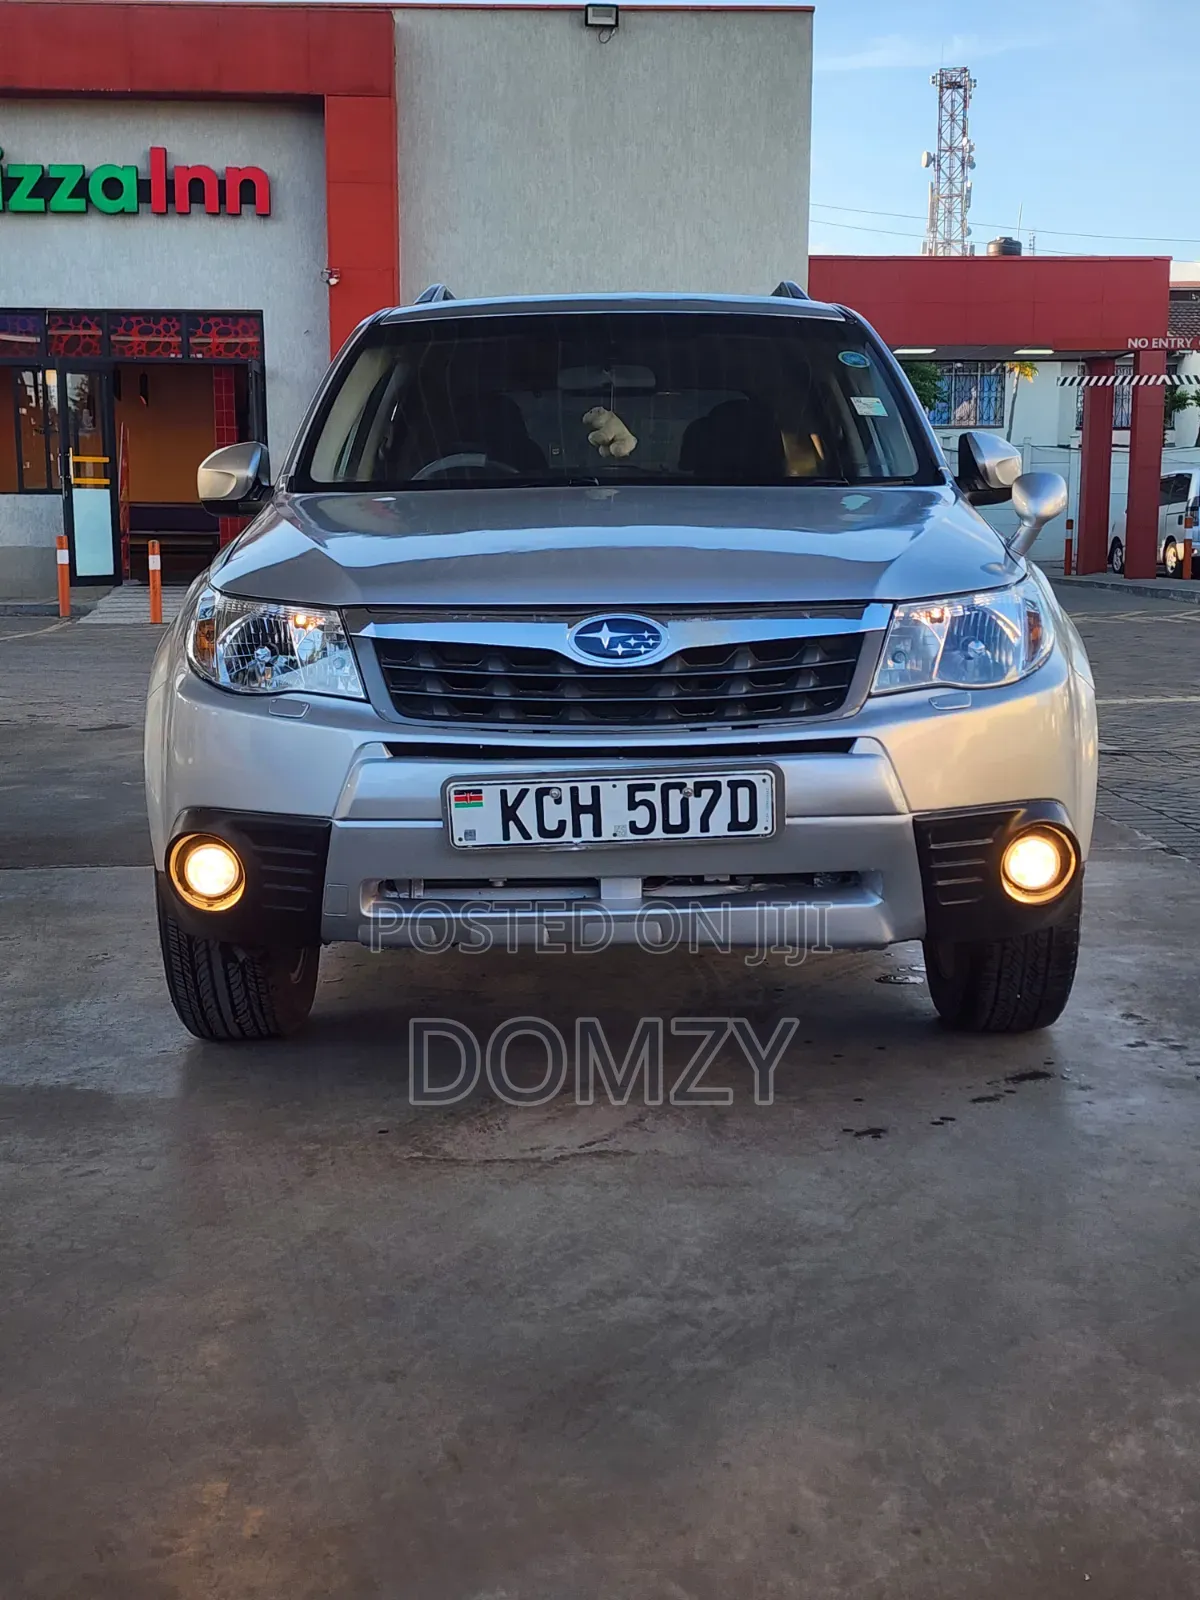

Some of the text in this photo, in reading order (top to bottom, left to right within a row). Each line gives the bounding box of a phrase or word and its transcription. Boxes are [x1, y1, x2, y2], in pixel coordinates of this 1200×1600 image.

[0, 146, 138, 214] zza
[1127, 337, 1194, 349] NO ENTRY
[500, 784, 601, 842] KCH
[627, 779, 758, 836] 507D
